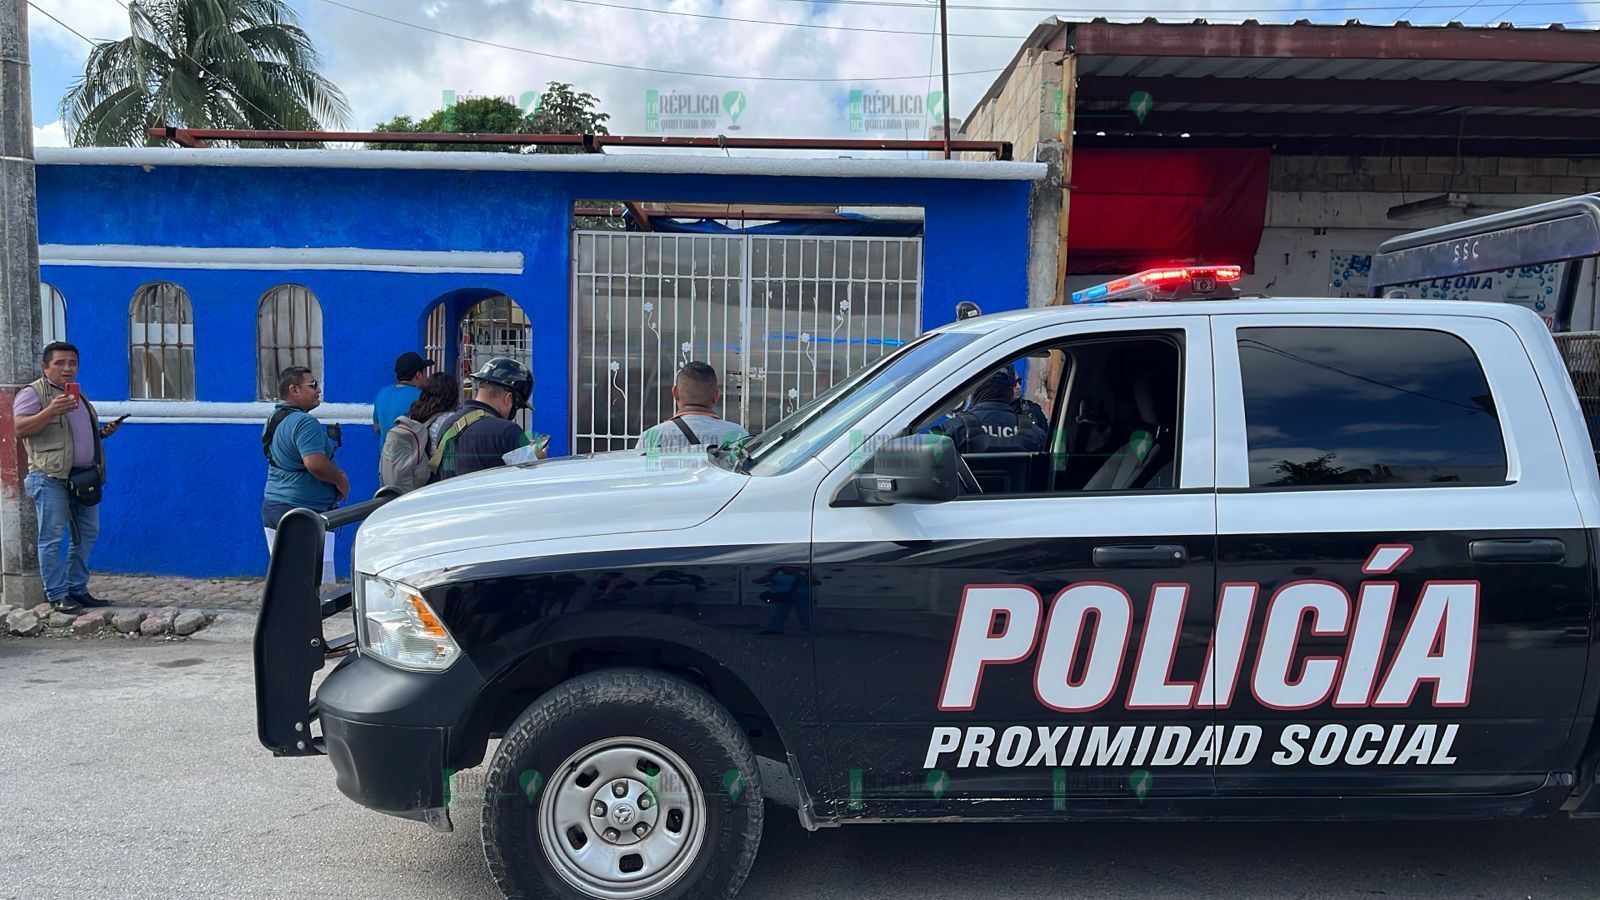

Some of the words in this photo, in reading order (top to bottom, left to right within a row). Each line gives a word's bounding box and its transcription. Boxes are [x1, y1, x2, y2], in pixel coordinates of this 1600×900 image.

[1453, 240, 1479, 262] SSC
[1430, 276, 1493, 290] LEONA
[937, 543, 1481, 711] POLICÍA
[923, 725, 1263, 769] PROXIMIDAD
[1272, 723, 1460, 765] SOCIAL
